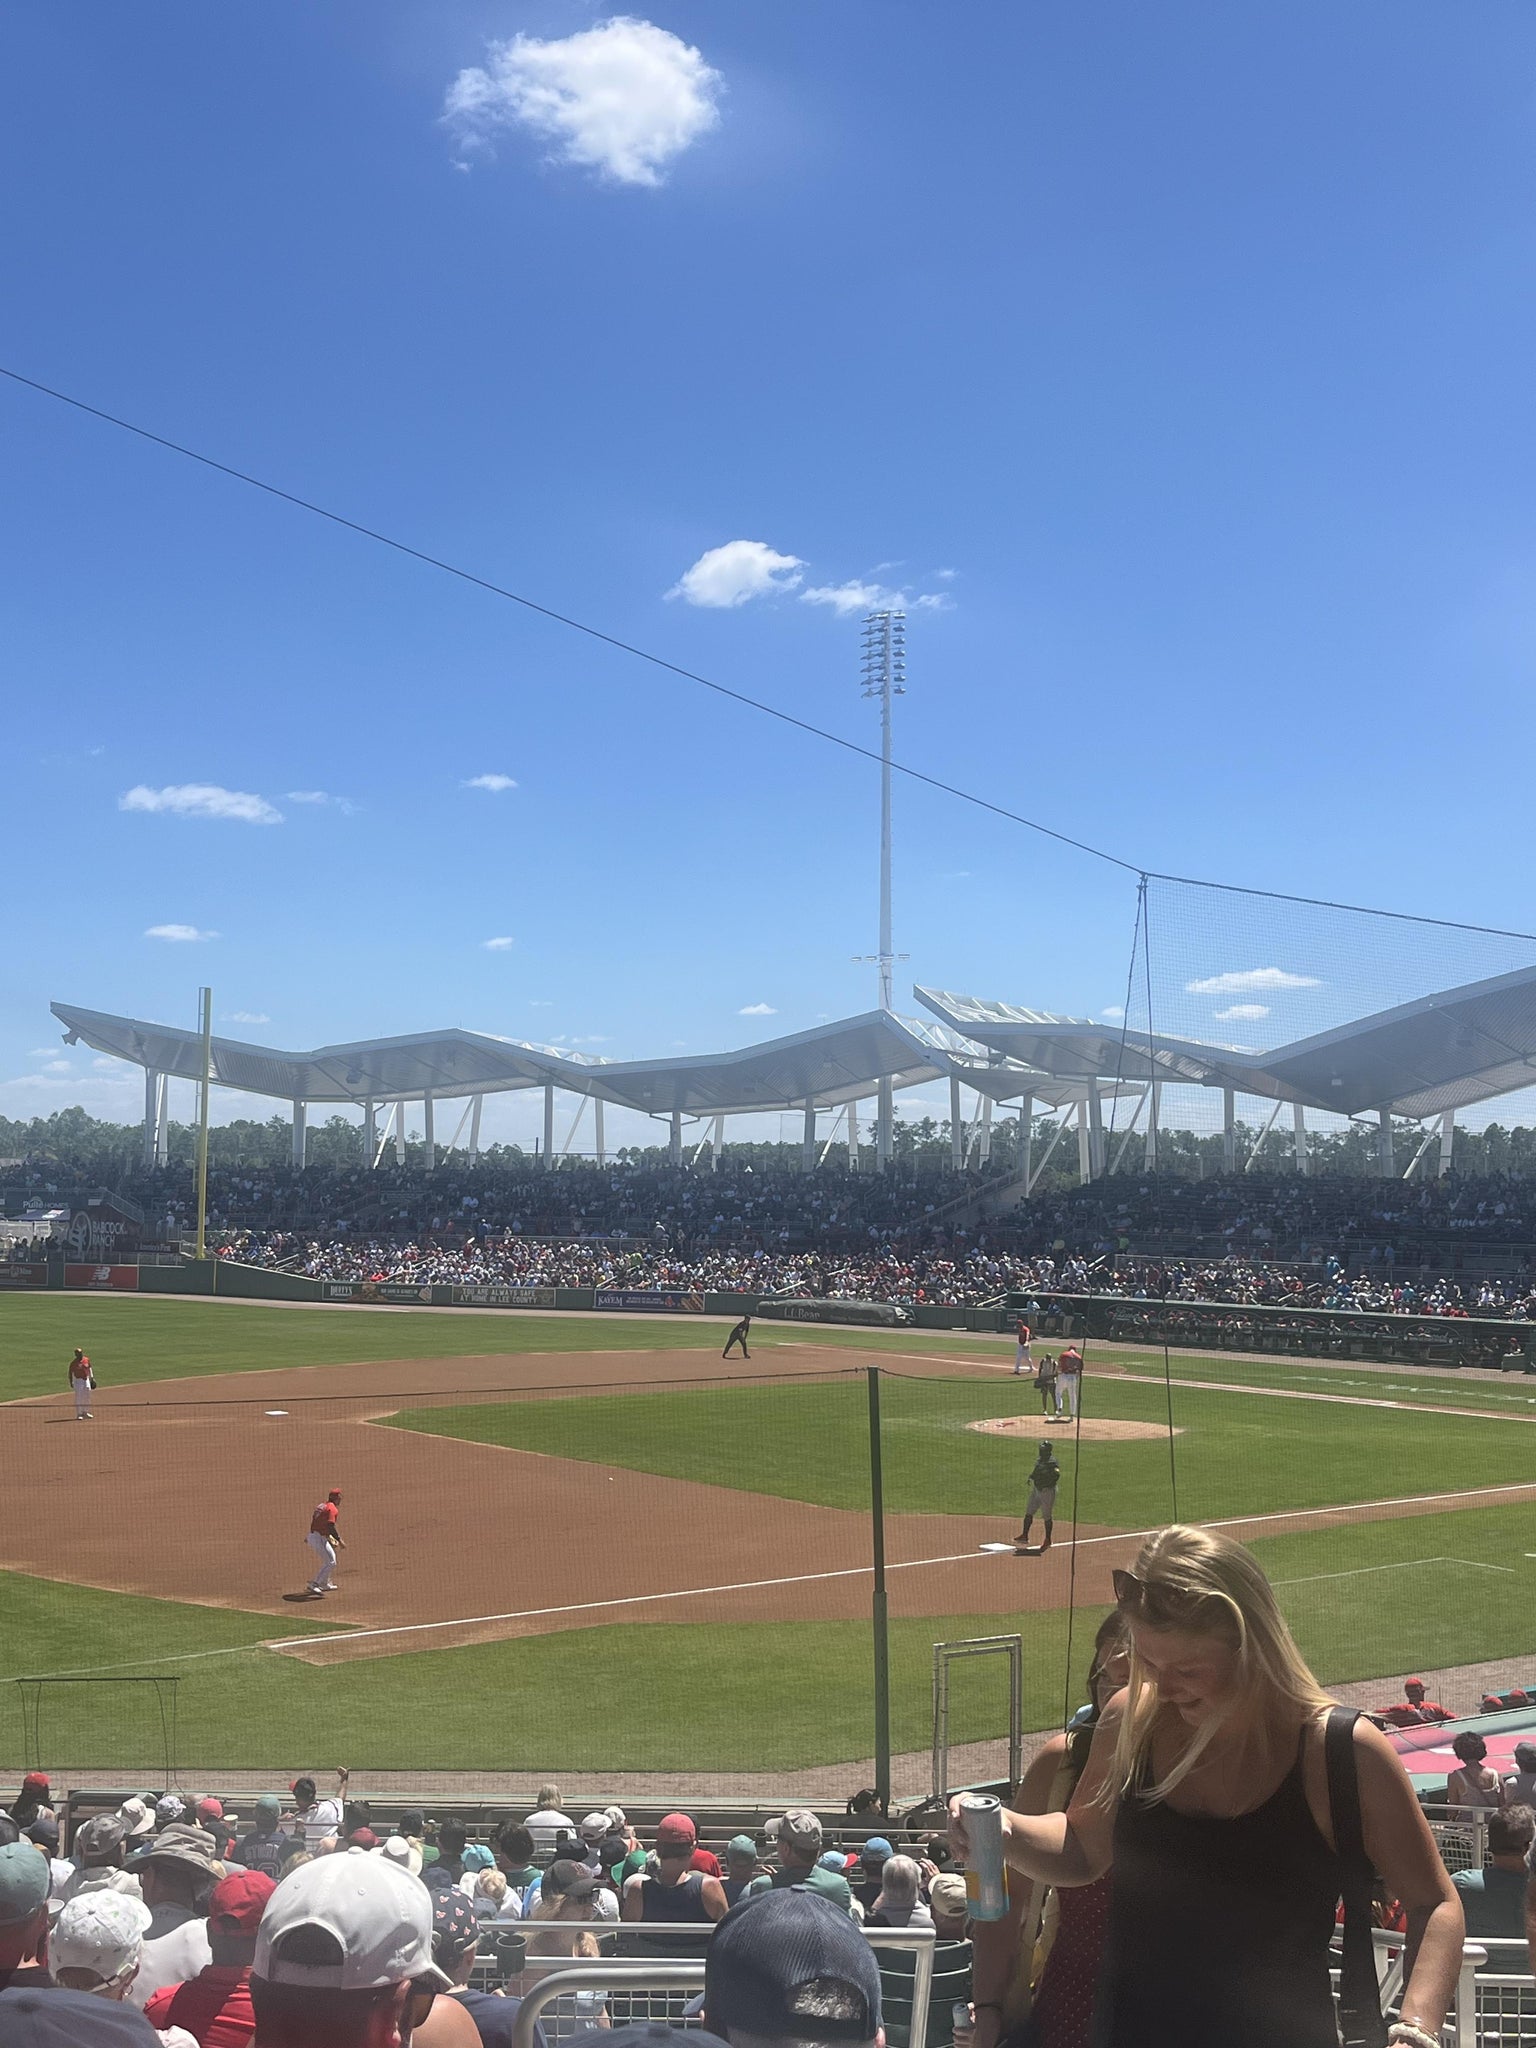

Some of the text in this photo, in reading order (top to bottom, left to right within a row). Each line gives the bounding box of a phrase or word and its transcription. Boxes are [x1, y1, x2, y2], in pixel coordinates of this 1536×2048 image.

[23, 1200, 43, 1209] Pulte
[93, 1221, 125, 1235] BABCOCK
[93, 1235, 116, 1247] RANCH
[462, 1287, 535, 1297] YOU ARE ALWAYS SAFE
[460, 1294, 468, 1302] AT
[513, 1296, 538, 1304] COUNTY
[598, 1295, 623, 1306] KAYEM
